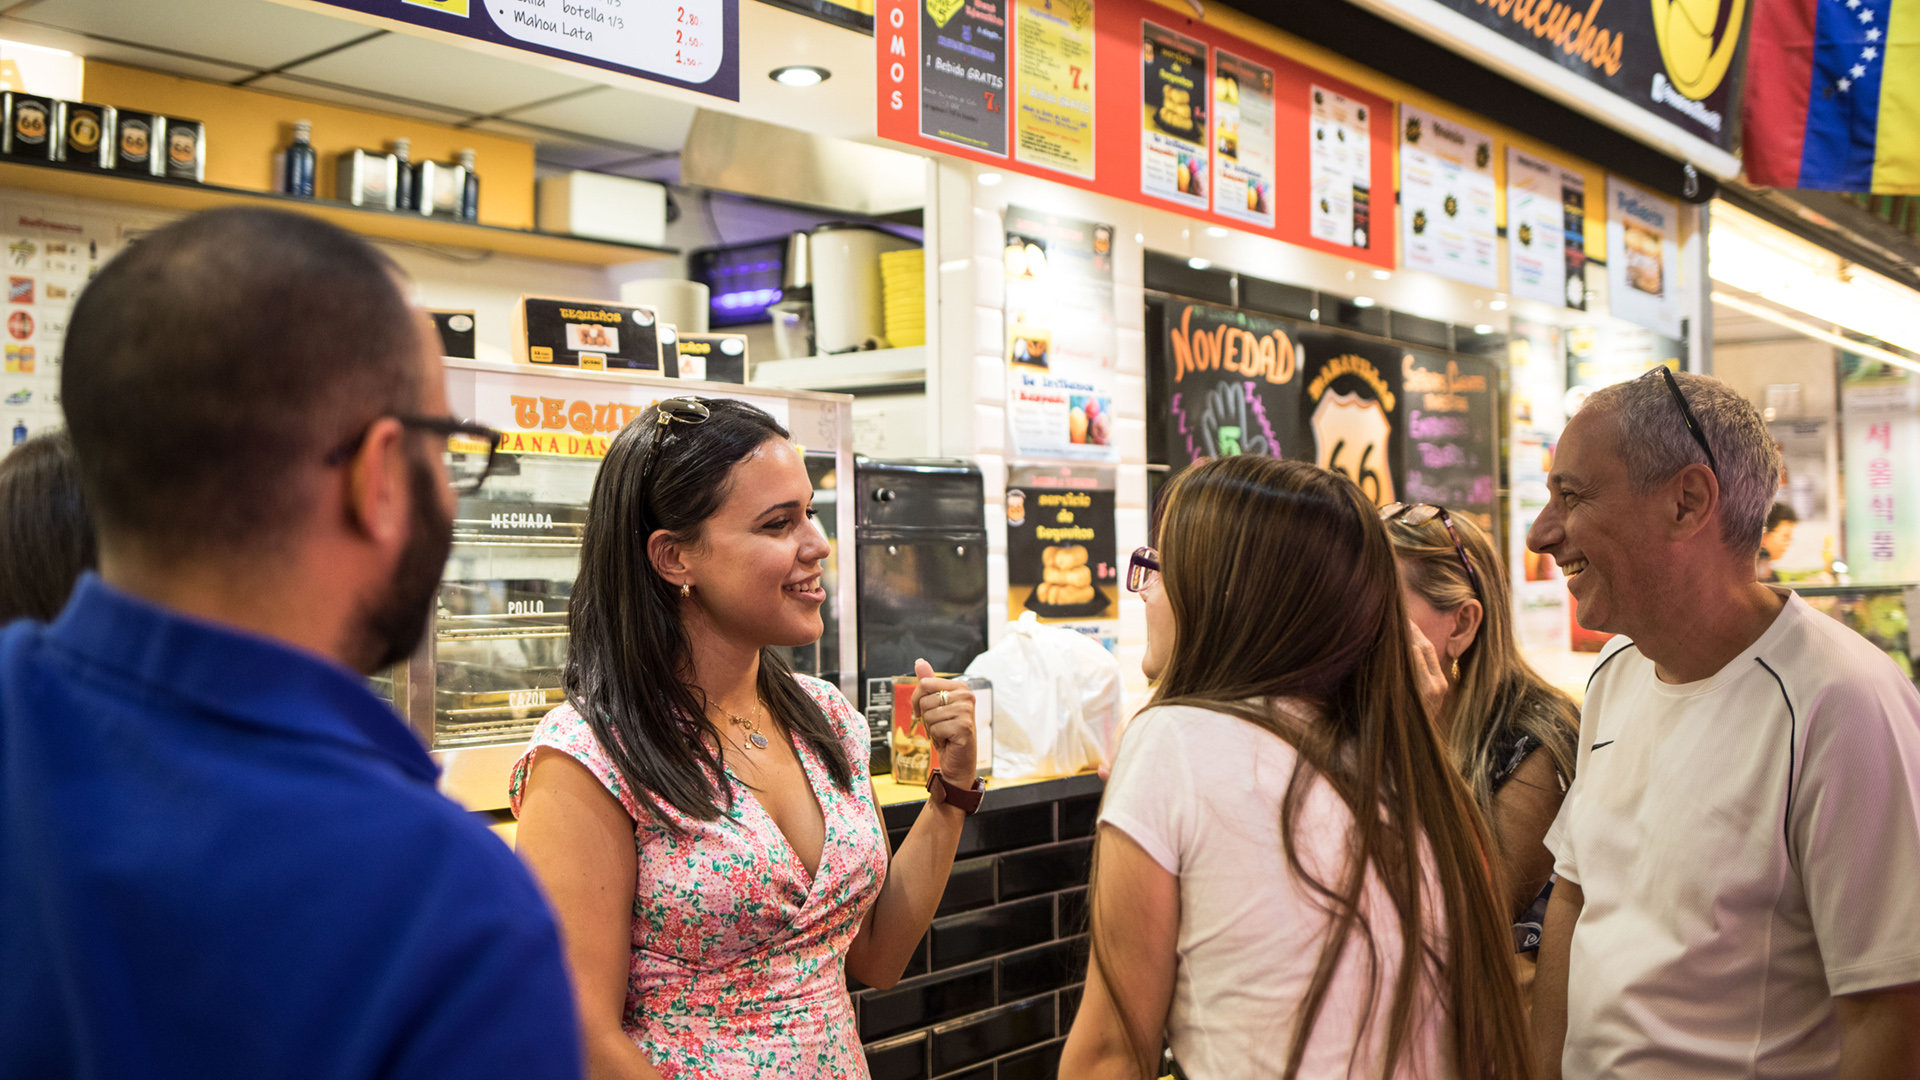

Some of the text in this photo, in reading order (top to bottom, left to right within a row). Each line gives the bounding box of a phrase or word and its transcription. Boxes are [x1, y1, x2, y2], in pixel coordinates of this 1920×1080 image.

[562, 0, 605, 24] botella
[513, 10, 558, 33] Mahou
[562, 22, 593, 42] Lata
[966, 67, 1004, 89] GRATIS
[21, 116, 42, 131] 66
[559, 307, 622, 323] TEQUEÑOS
[1170, 305, 1296, 385] NOVEDAD
[510, 395, 660, 435] TEQUE
[501, 433, 609, 457] PANADAS
[491, 512, 553, 529] MECHADA
[508, 600, 544, 615] POLLO
